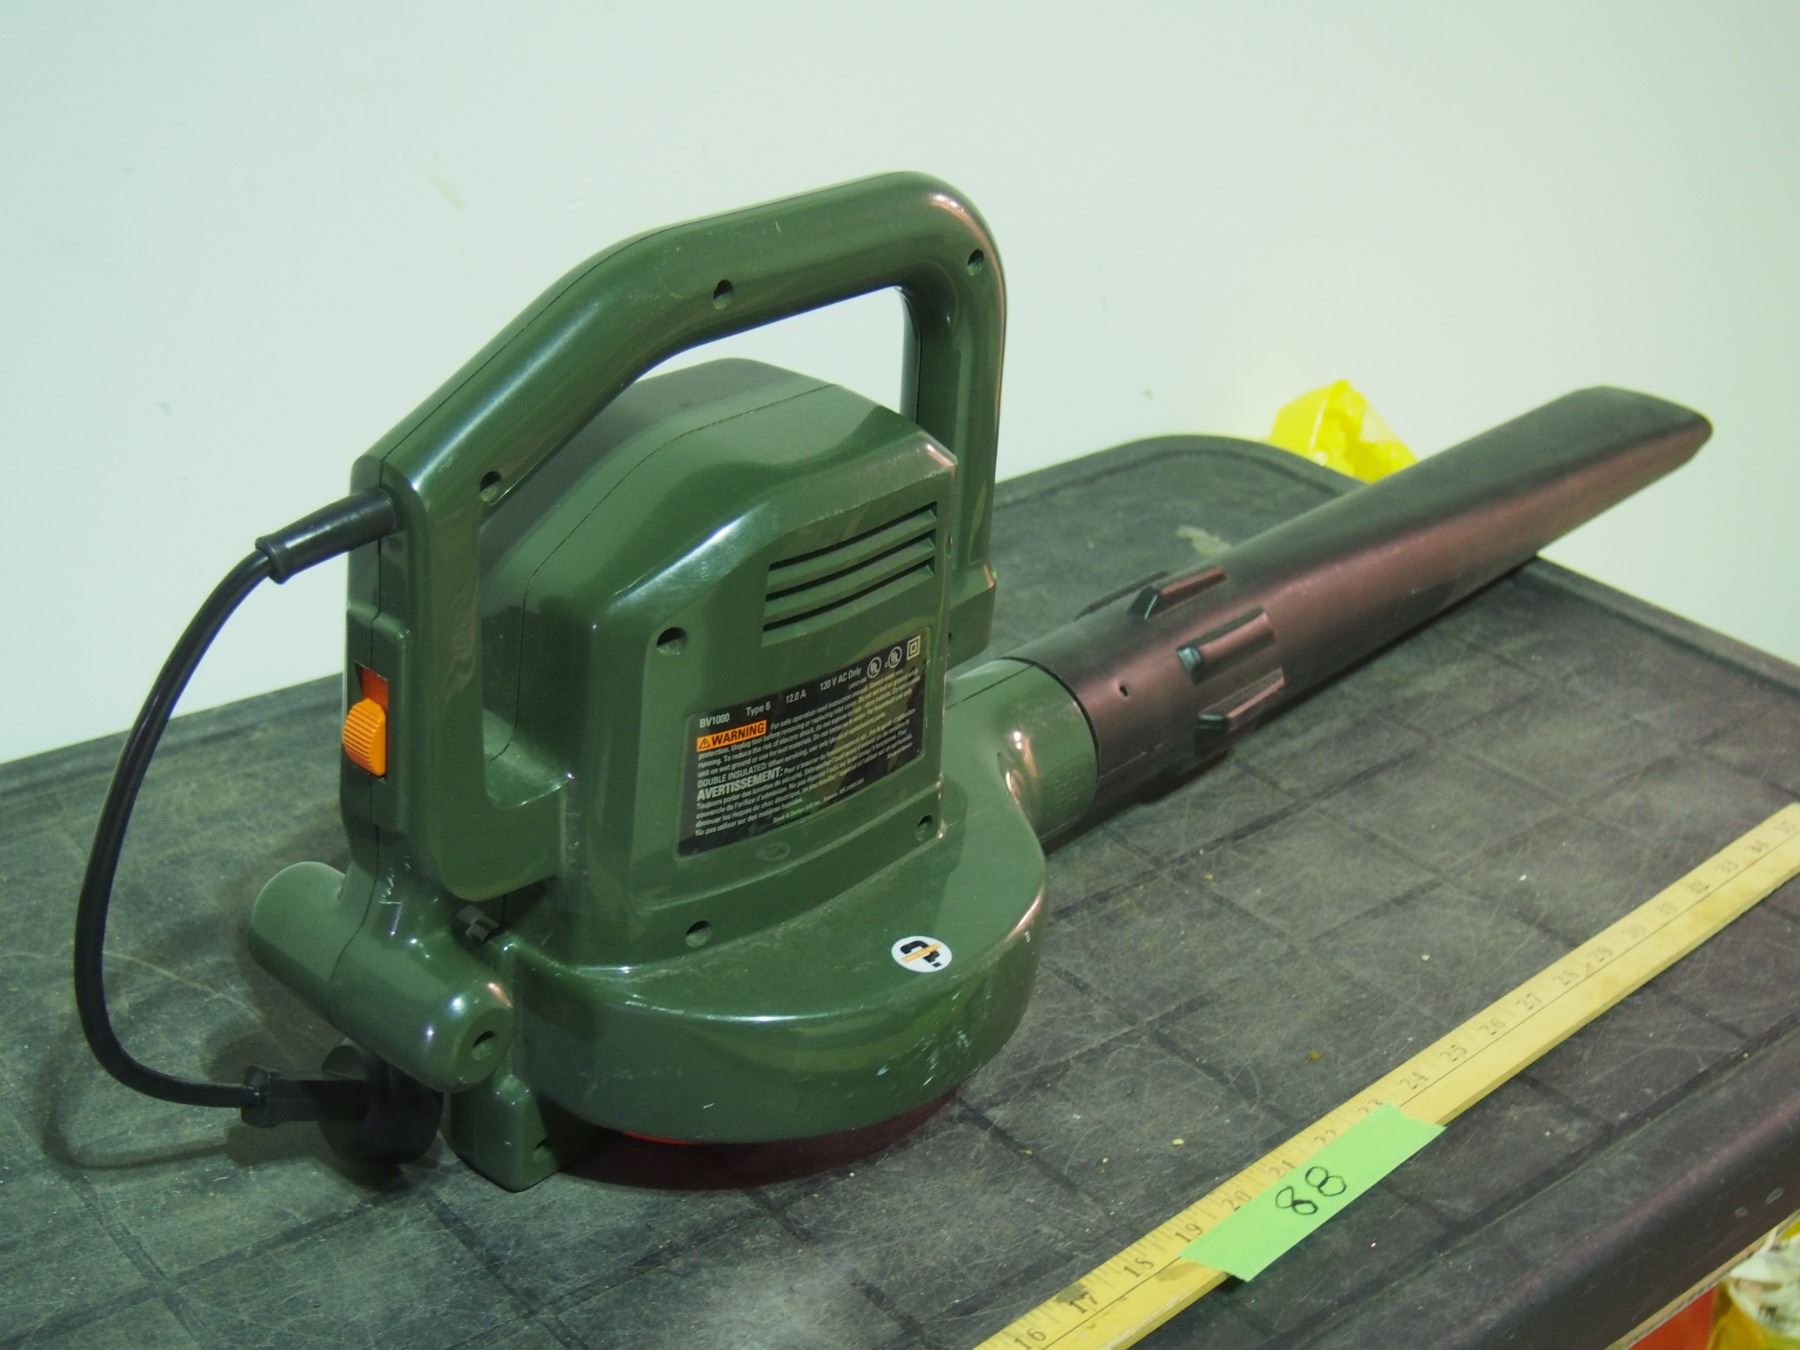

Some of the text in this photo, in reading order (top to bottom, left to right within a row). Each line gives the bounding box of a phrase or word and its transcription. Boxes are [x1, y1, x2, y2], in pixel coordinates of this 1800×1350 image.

[832, 676, 838, 686] V
[838, 672, 848, 684] AC
[848, 667, 862, 680] Only
[800, 689, 807, 698] A
[746, 701, 771, 717] Type 6
[700, 713, 730, 728] BV1000
[712, 722, 764, 746] WARNING
[697, 766, 783, 801] AVERTISSEMENT:
[698, 774, 727, 788] DOUBLE
[1014, 1327, 1047, 1350] 16
[1068, 1291, 1099, 1314] 17
[1175, 1223, 1204, 1243] 19
[1223, 1190, 1252, 1211] 20
[1400, 1071, 1428, 1090] 24
[1440, 1044, 1467, 1062] 25
[1478, 1018, 1506, 1035] 26
[1516, 992, 1542, 1010] 27
[1276, 1166, 1347, 1215] 88
